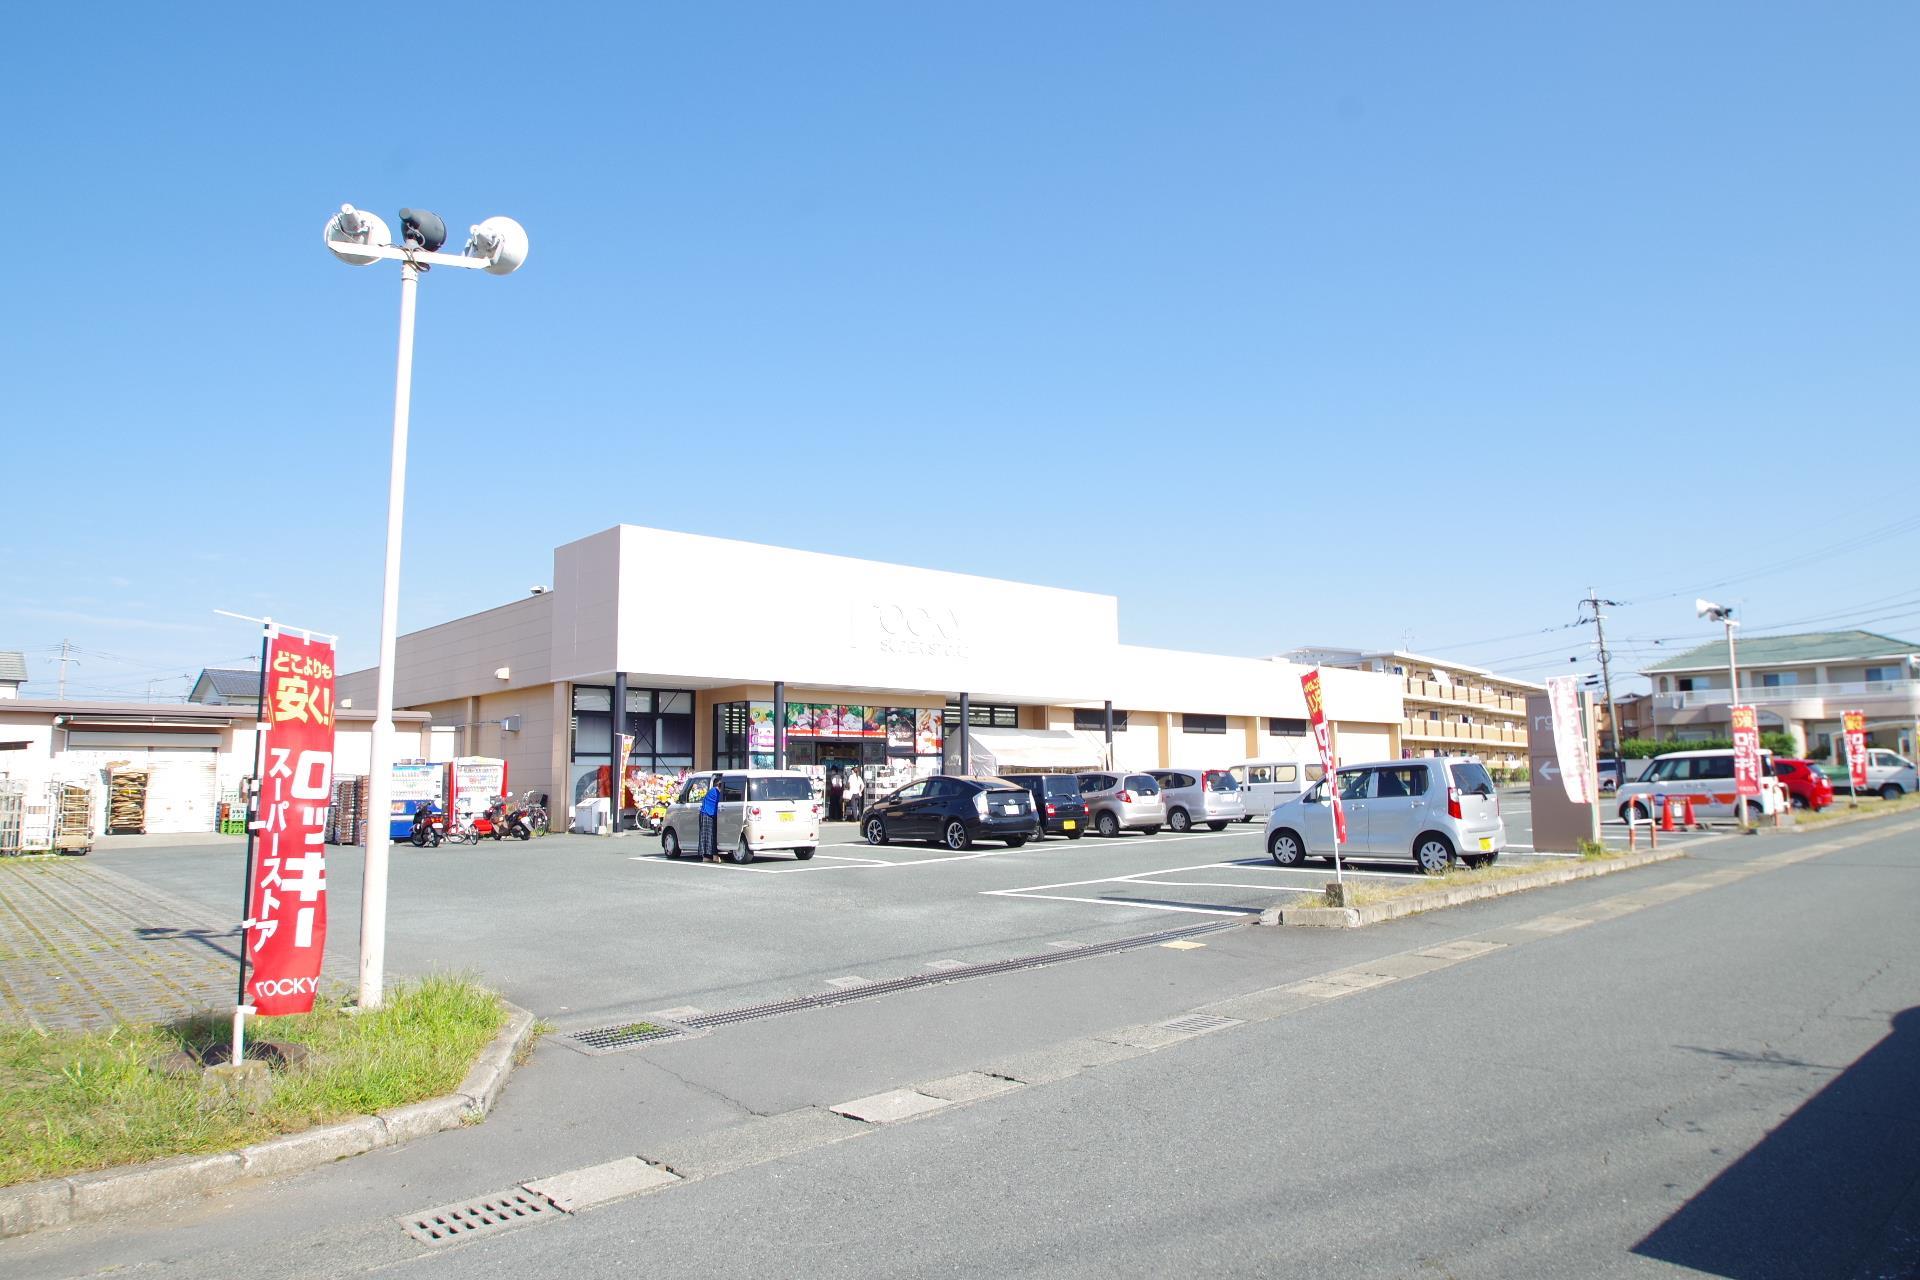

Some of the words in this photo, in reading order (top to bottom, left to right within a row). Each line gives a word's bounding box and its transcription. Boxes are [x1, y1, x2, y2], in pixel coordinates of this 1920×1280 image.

[273, 650, 333, 680] どこよりも
[275, 675, 330, 727] 安く!
[253, 748, 293, 953] スーパーストア
[281, 750, 333, 948] ロッキー
